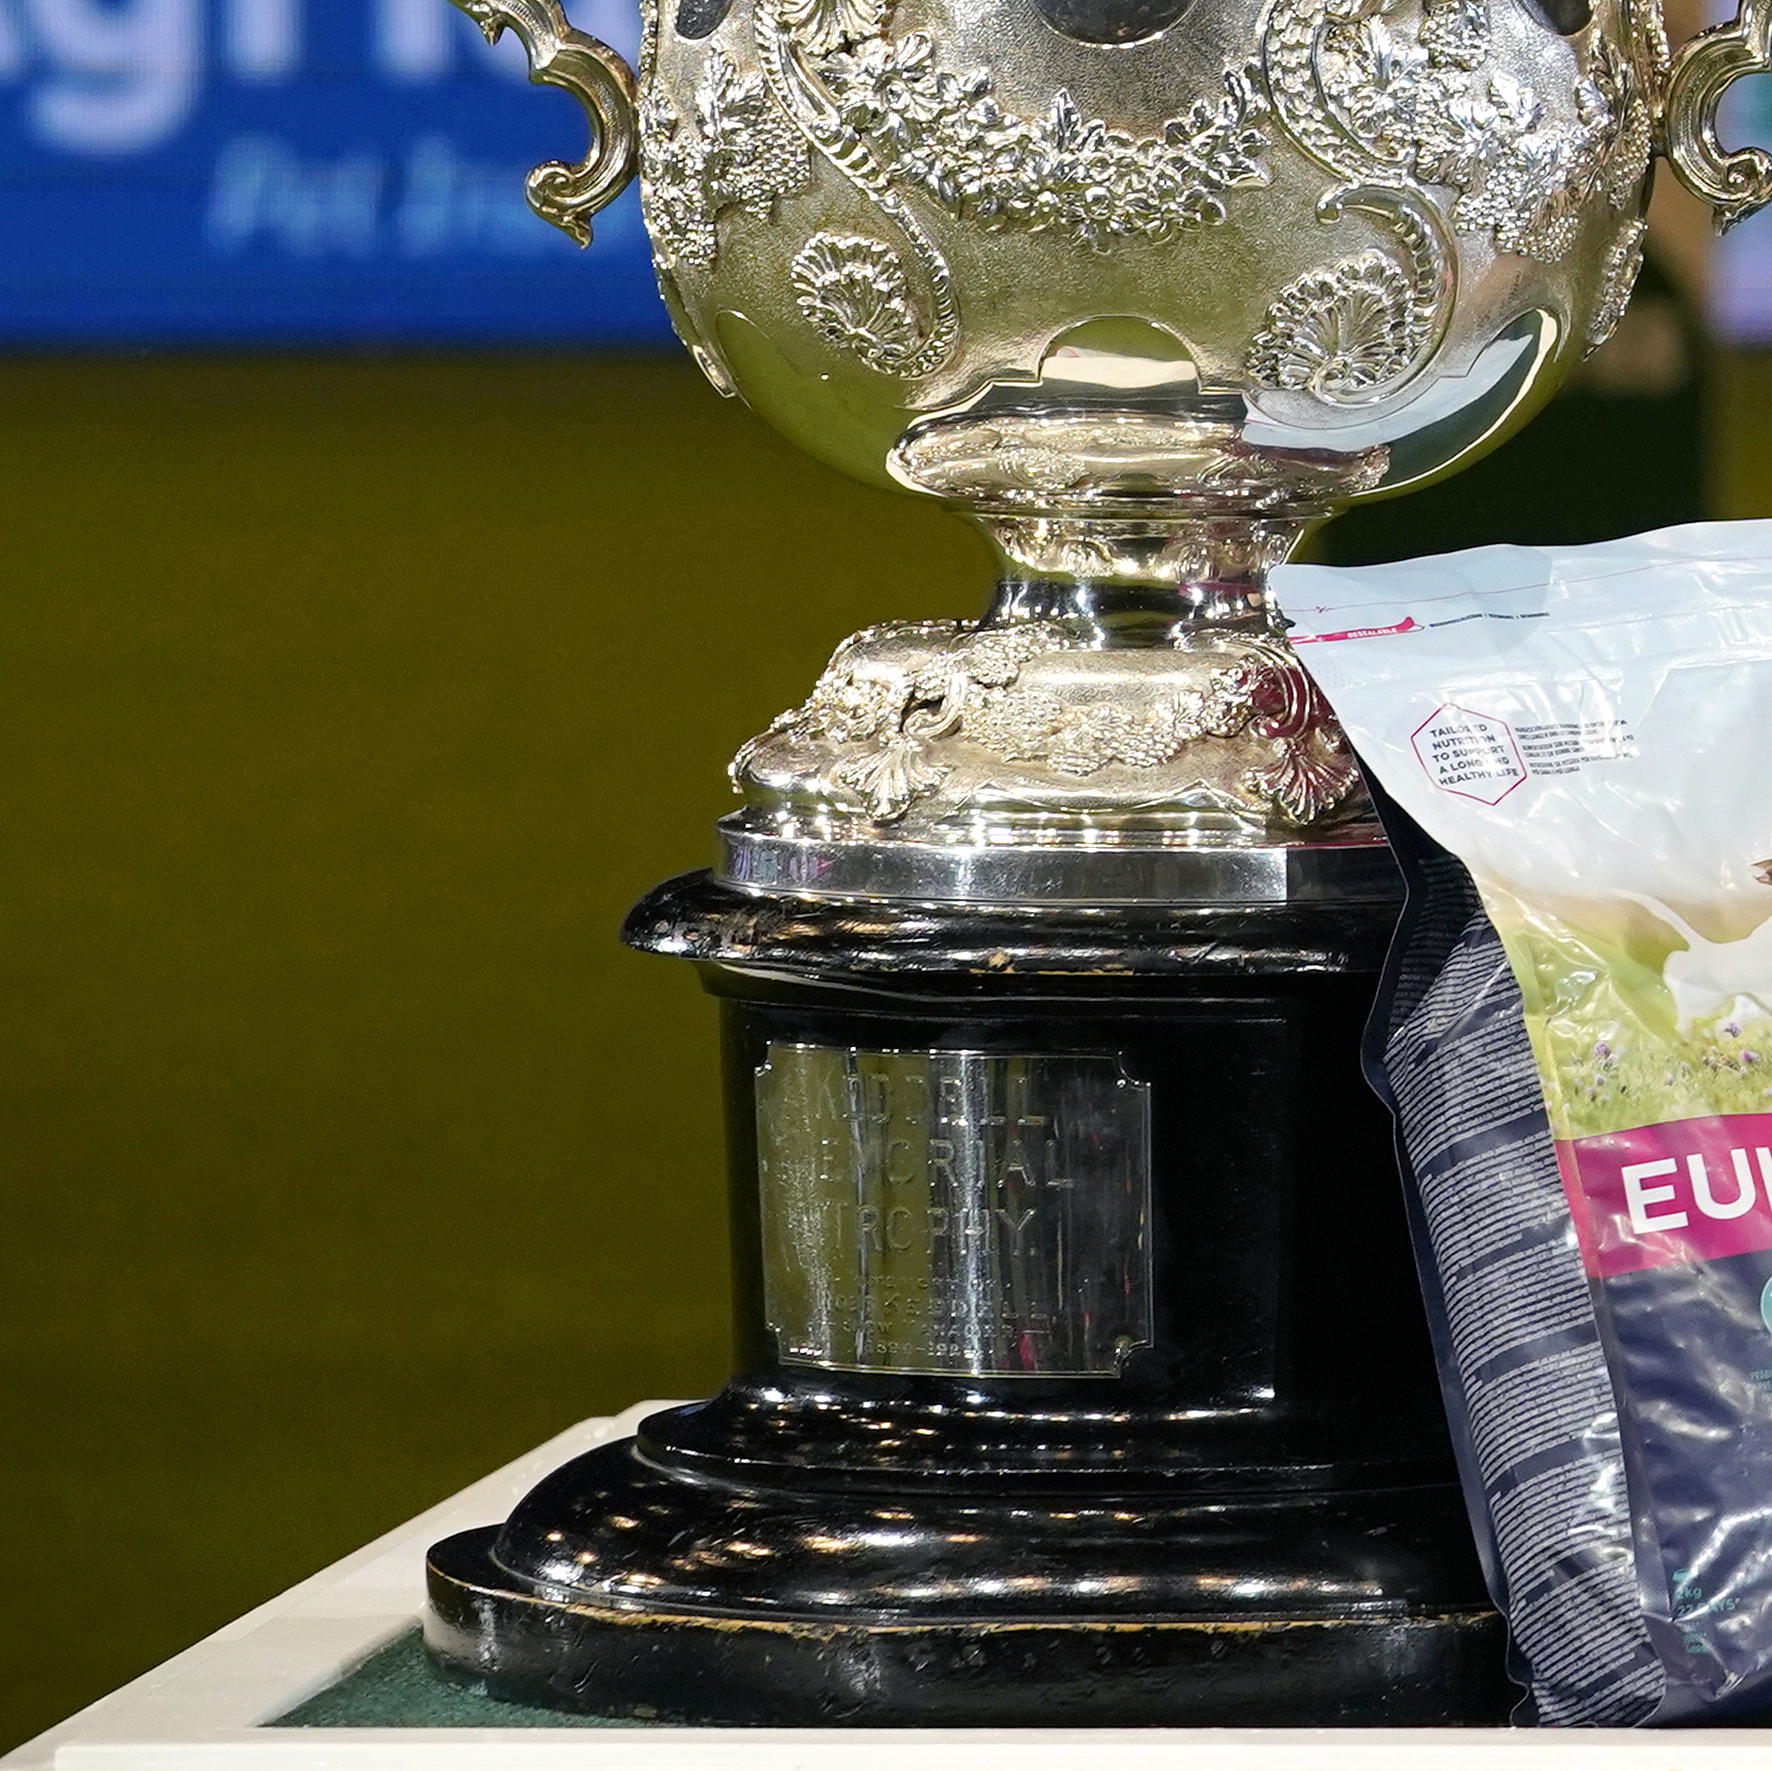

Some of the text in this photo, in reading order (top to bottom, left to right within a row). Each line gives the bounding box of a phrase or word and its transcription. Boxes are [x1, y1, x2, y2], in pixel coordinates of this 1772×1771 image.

[1432, 752, 1450, 763] TO
[1439, 766, 1448, 774] A
[1450, 759, 1483, 771] LONG
[1439, 768, 1519, 786] HEALTHY LIFE
